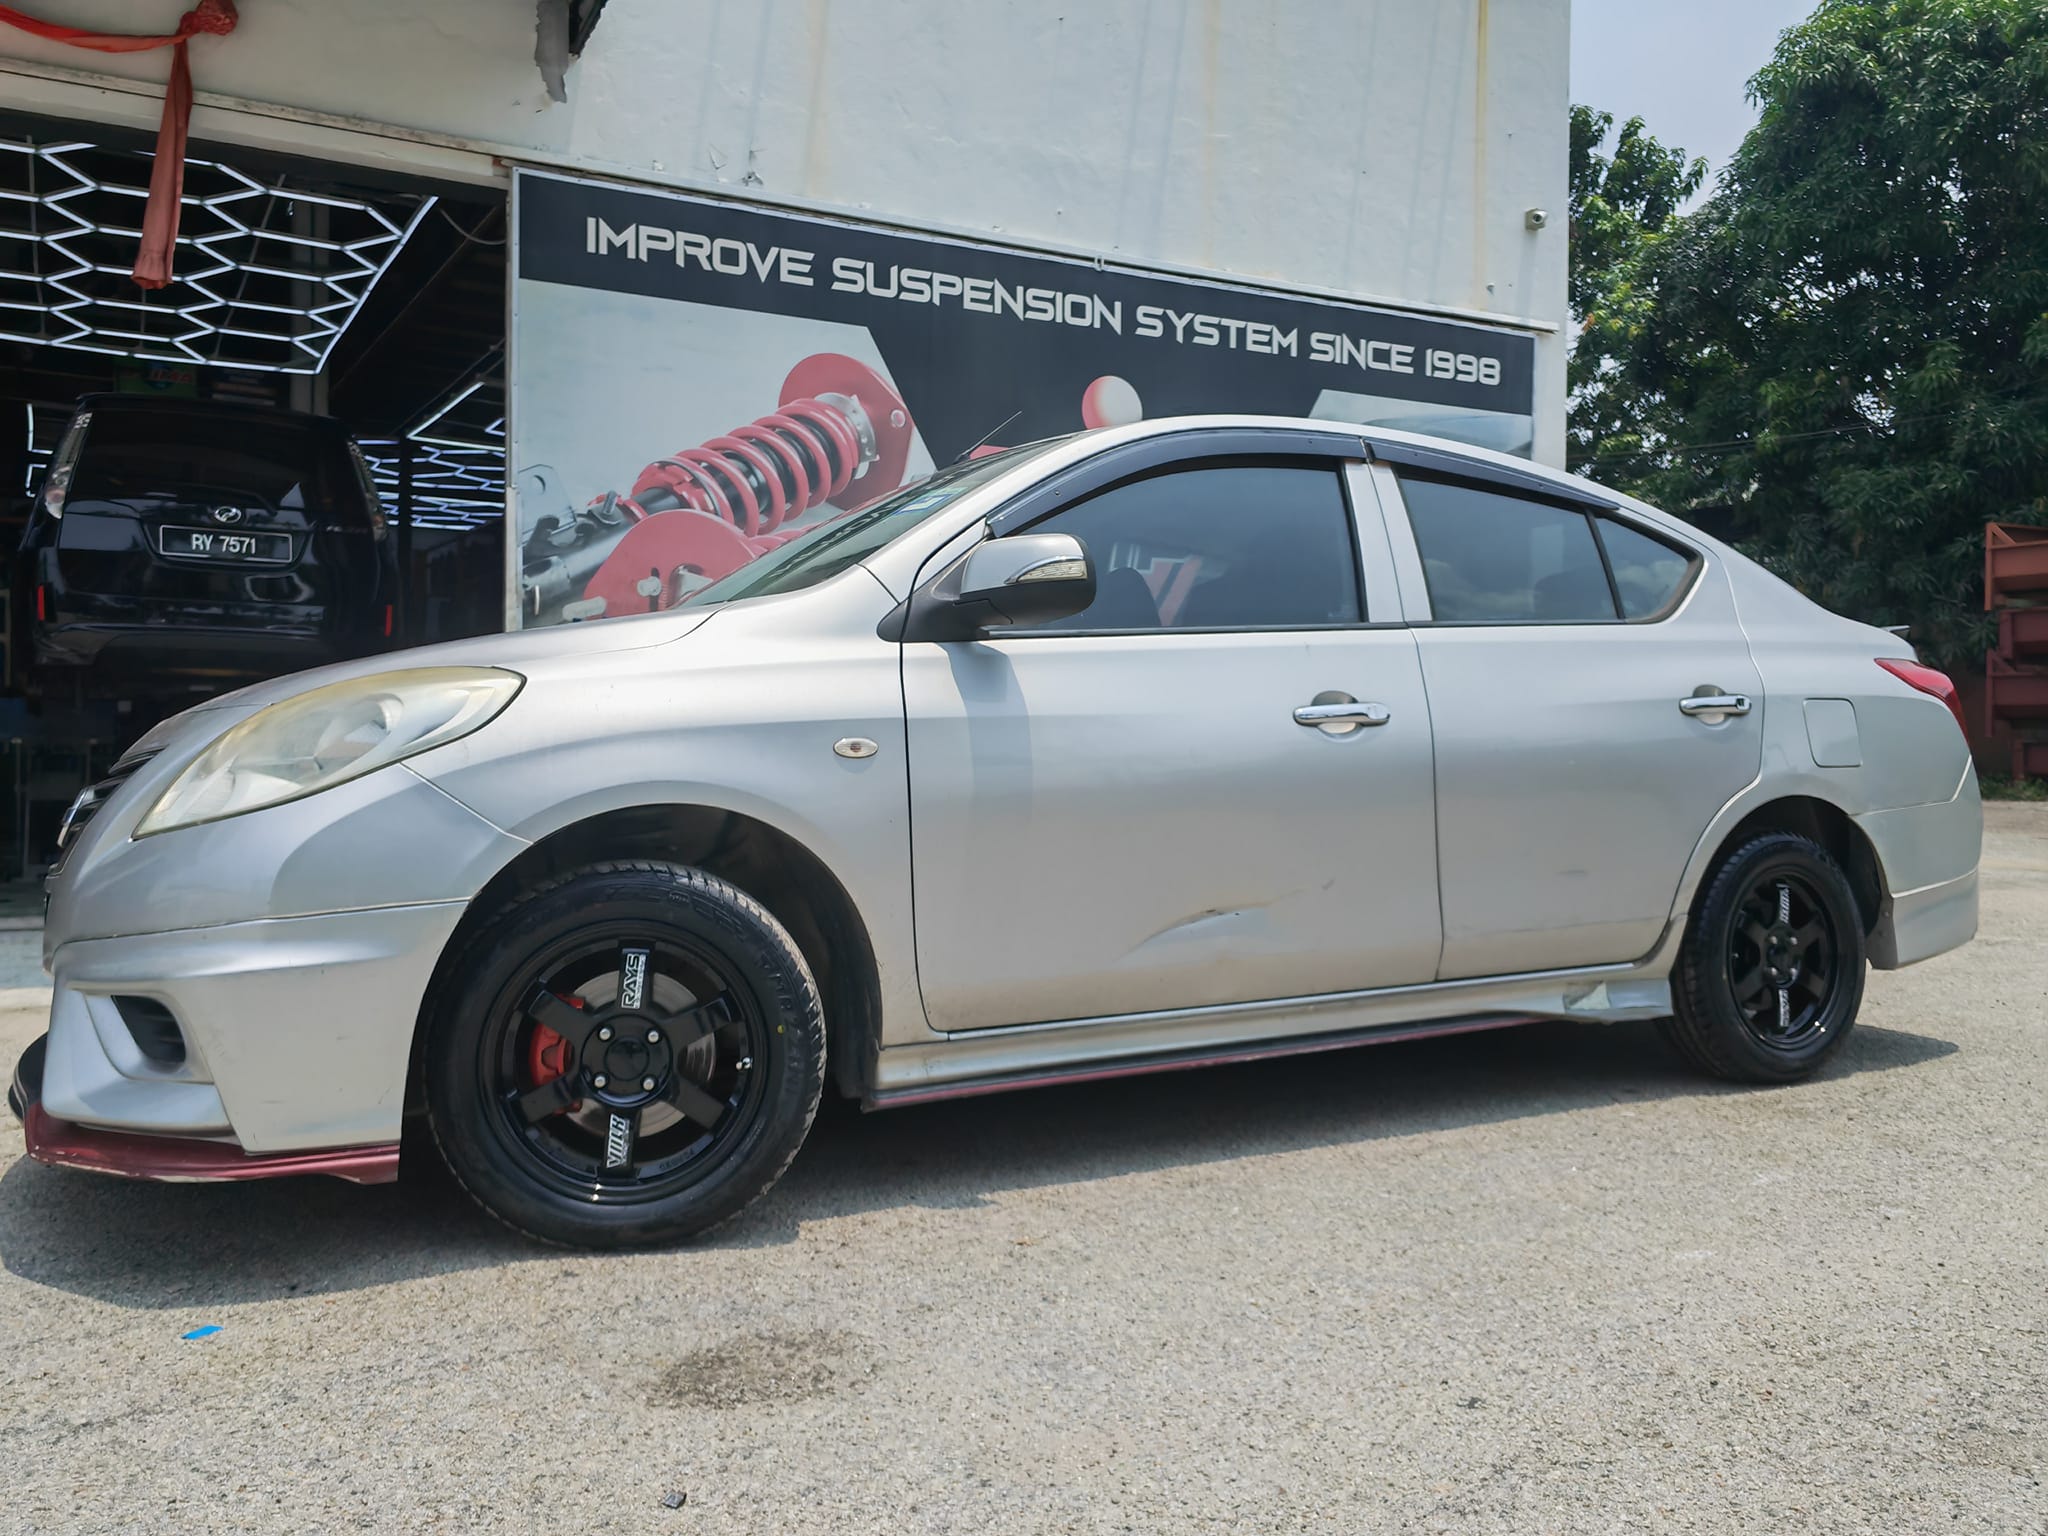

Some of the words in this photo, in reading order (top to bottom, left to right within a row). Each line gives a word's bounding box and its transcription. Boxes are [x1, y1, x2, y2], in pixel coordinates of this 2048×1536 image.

[587, 218, 814, 286] IMPROVE
[832, 258, 1121, 335] SUSPENSION
[1135, 306, 1297, 357] SYSTEM
[1309, 332, 1414, 374] SINCE
[1426, 349, 1500, 385] 1998
[192, 534, 213, 551] RY
[220, 536, 255, 553] 7571
[622, 954, 640, 1008] RAYS
